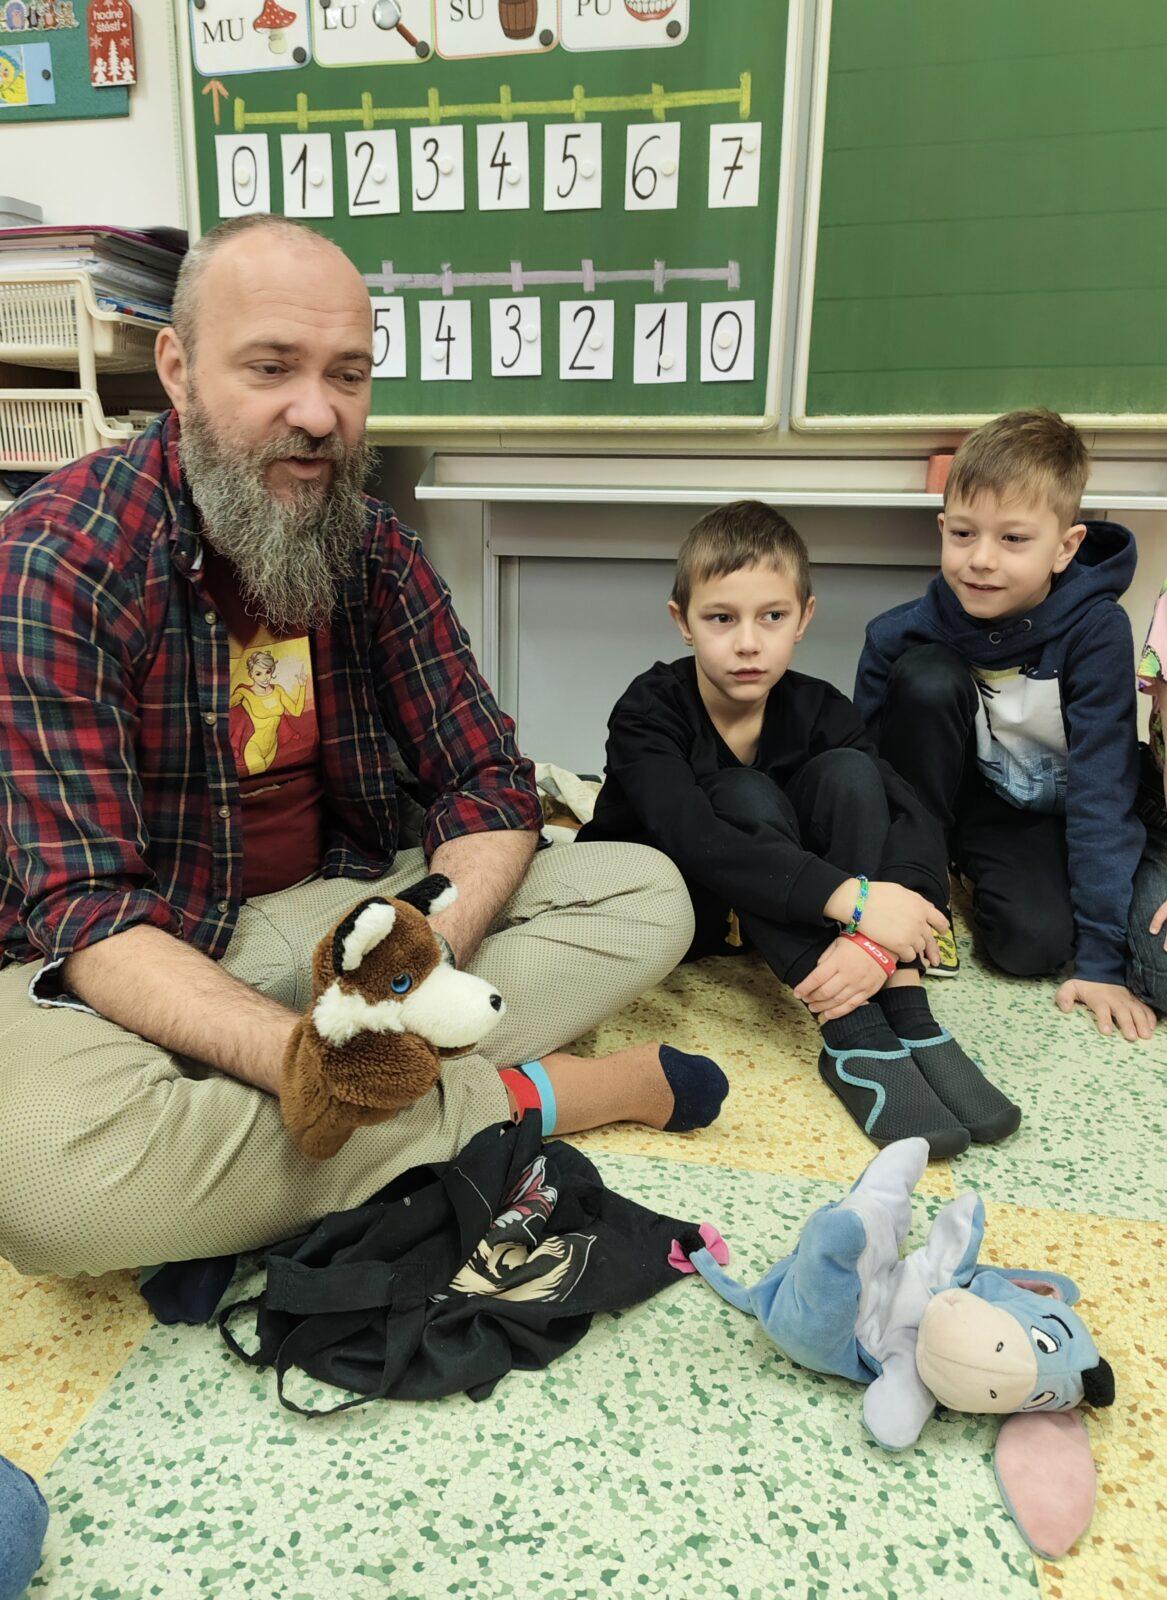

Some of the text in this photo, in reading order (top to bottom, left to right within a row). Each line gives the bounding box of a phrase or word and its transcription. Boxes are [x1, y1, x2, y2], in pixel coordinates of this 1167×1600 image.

[323, 5, 358, 30] LU
[450, 0, 485, 21] SU
[576, 0, 612, 16] PU
[203, 18, 245, 43] MU
[232, 131, 743, 209] 0 1 2 3 4 5 6 7
[372, 304, 743, 376] 5 4 3 2 1 0
[863, 941, 889, 964] CCM
